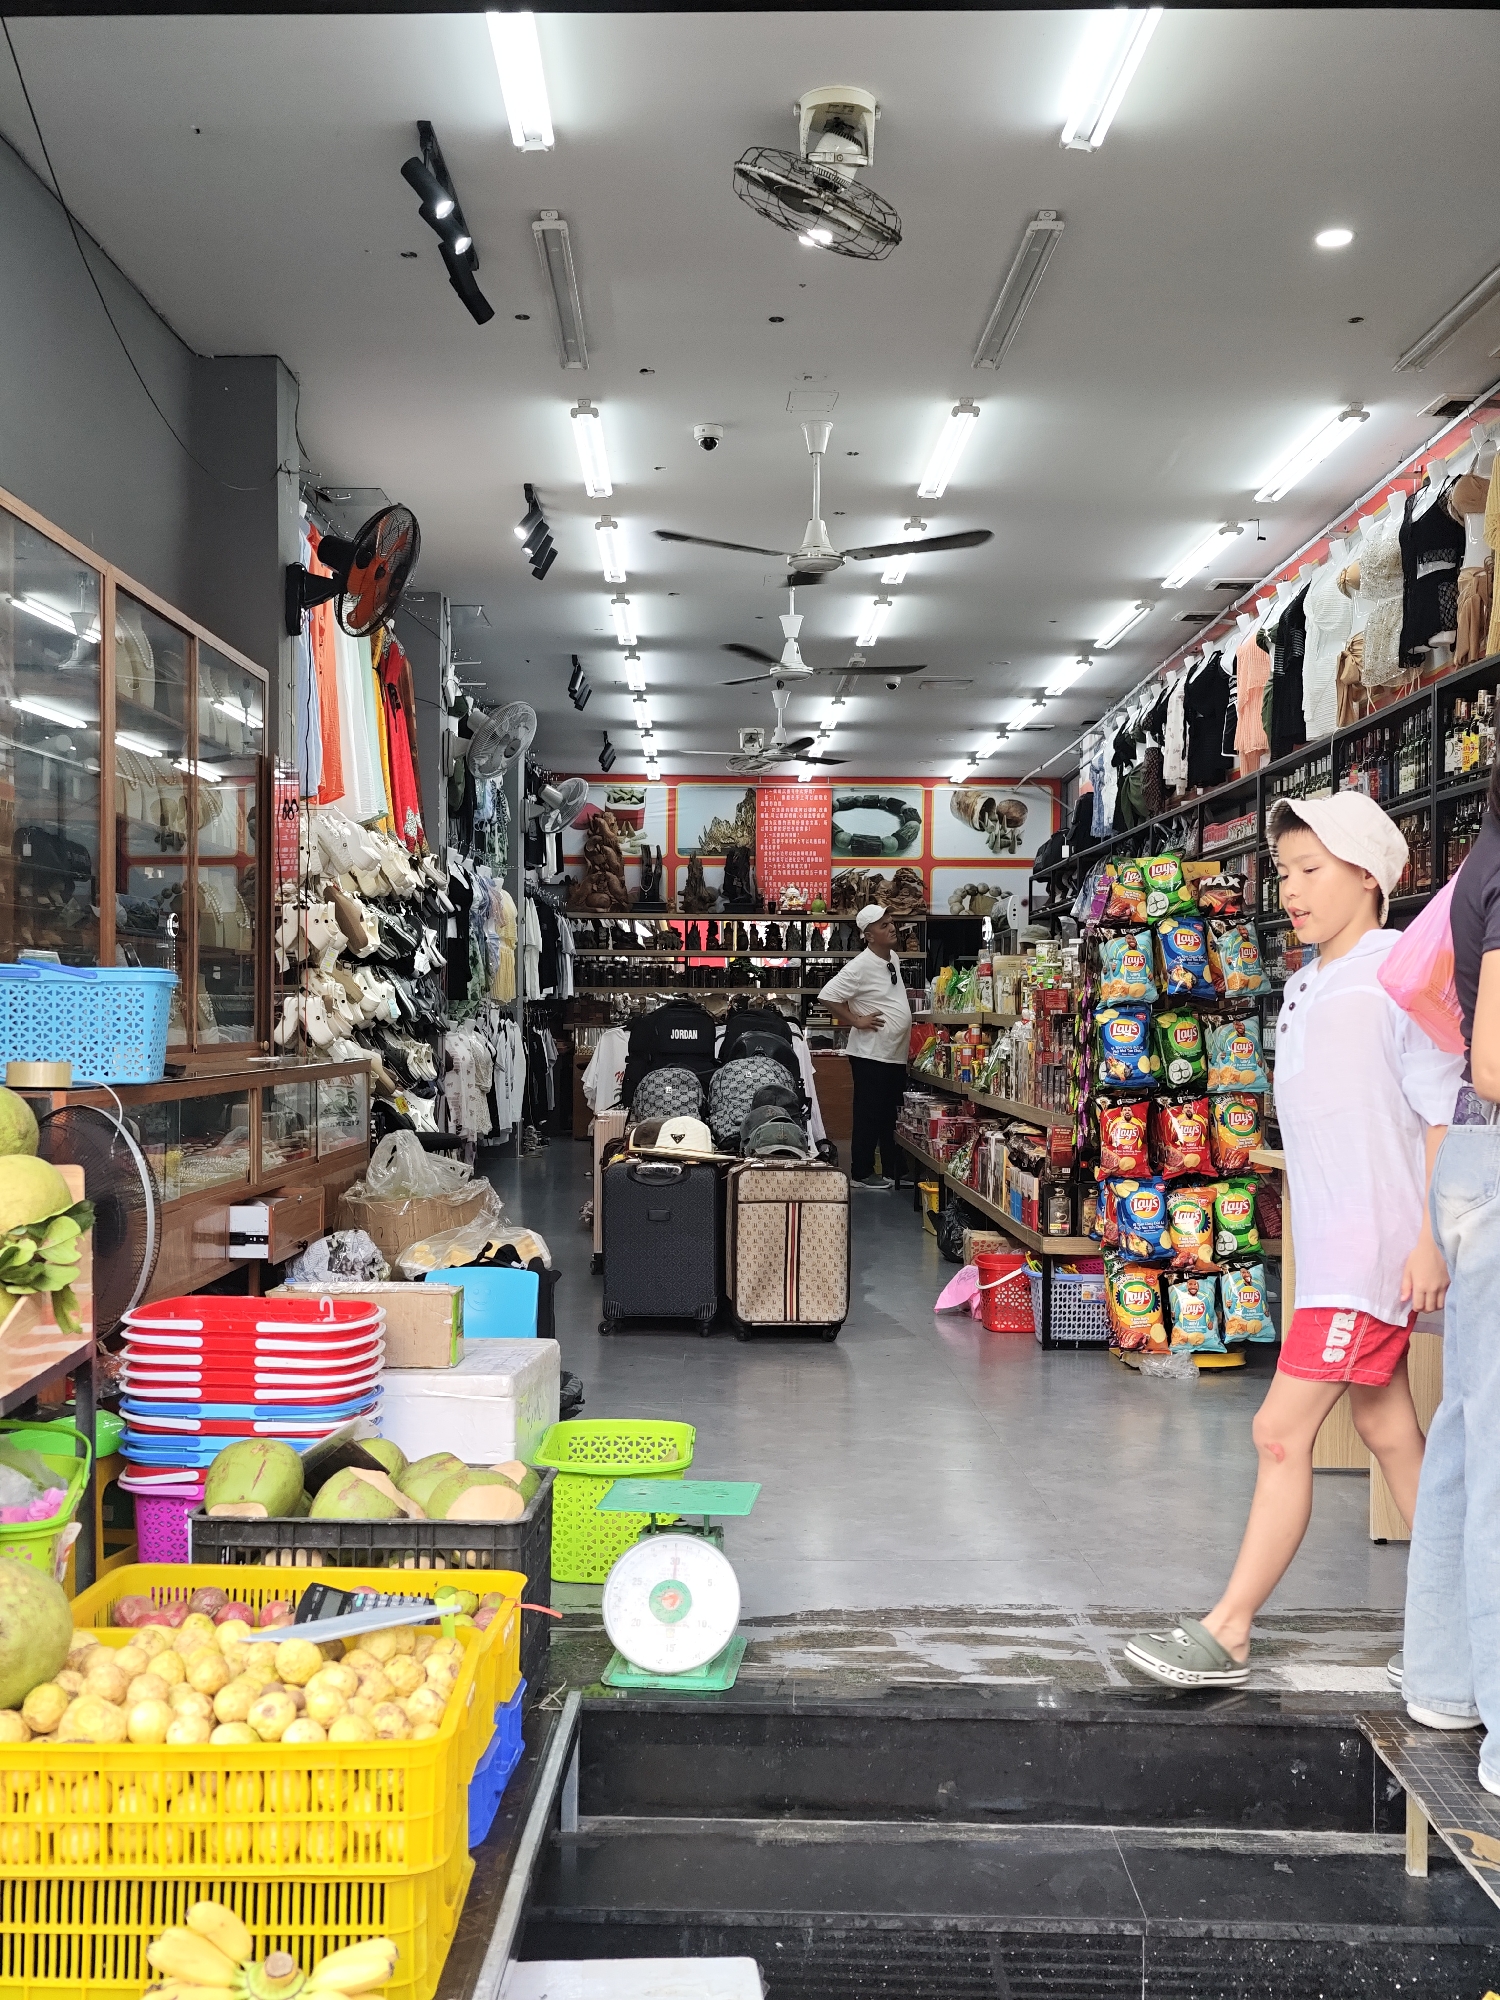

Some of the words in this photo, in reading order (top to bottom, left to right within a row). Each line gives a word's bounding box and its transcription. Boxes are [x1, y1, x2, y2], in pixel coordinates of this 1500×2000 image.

[1150, 862, 1178, 877] Lay's
[1199, 876, 1241, 888] MAX
[1176, 934, 1201, 946] Lay's
[1240, 946, 1258, 958] Lay's
[1124, 955, 1145, 966] Lay's
[670, 1029, 698, 1040] JORDAN
[1113, 1023, 1139, 1037] Lay's
[1176, 1025, 1198, 1042] Lay's
[1233, 1042, 1254, 1053] Lay's
[1230, 1111, 1254, 1125] Lay's
[1117, 1128, 1138, 1140] Lay's
[1133, 1197, 1159, 1212] Lay's
[1223, 1199, 1250, 1214] Lay's
[1125, 1290, 1150, 1305] Lay's
[1240, 1291, 1260, 1303] Lay's
[1322, 1307, 1359, 1363] SUR
[632, 1577, 643, 1586] 25
[707, 1579, 713, 1587] 5
[631, 1618, 641, 1627] 20
[698, 1619, 707, 1628] 10
[665, 1644, 675, 1652] 15
